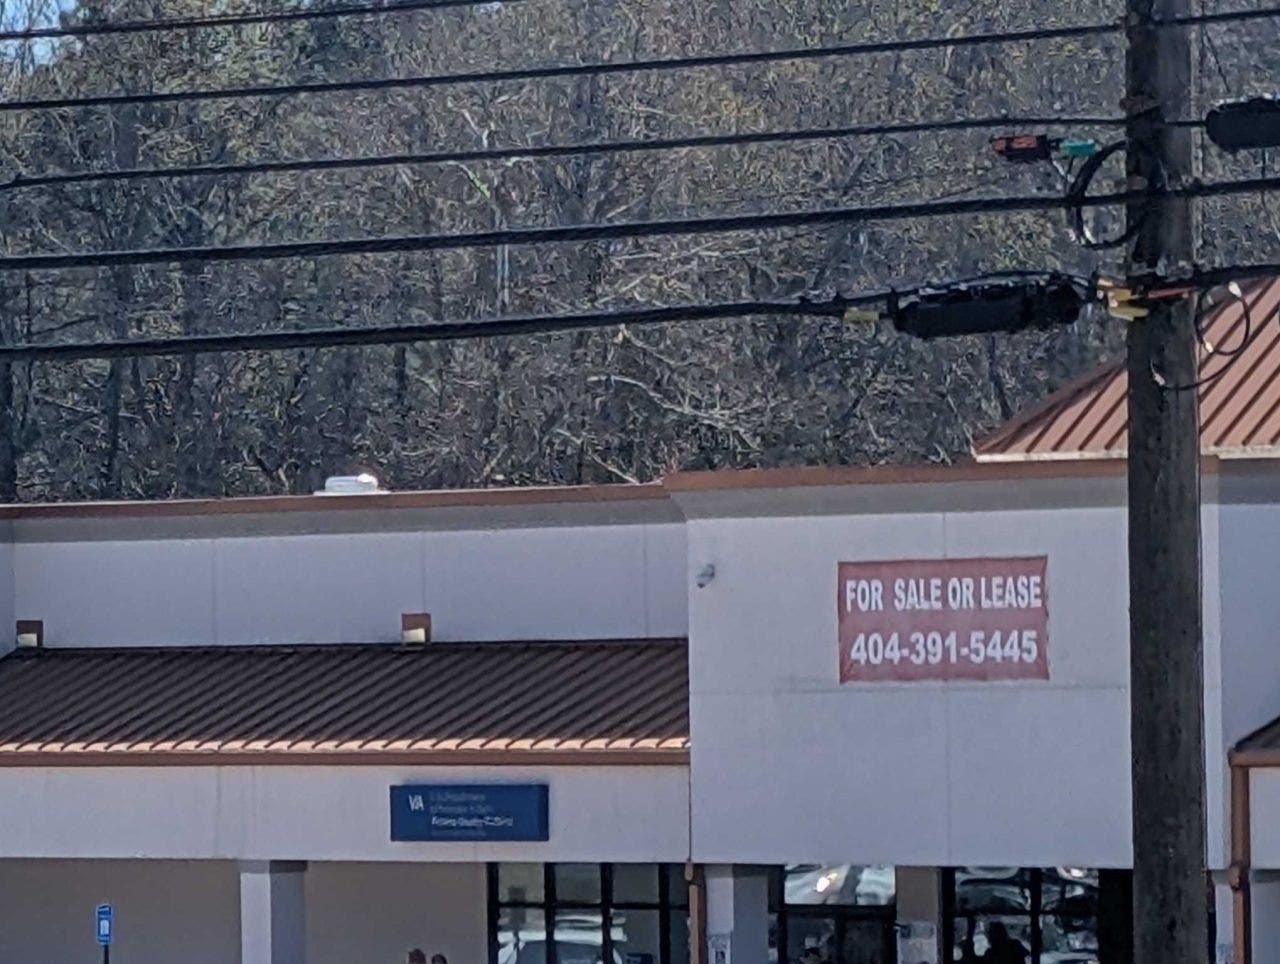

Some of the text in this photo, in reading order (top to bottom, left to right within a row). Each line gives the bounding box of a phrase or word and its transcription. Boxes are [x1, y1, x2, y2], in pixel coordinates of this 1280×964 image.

[845, 575, 1043, 613] FOR SALE OR LEASE
[850, 630, 1038, 666] 404-391-5445
